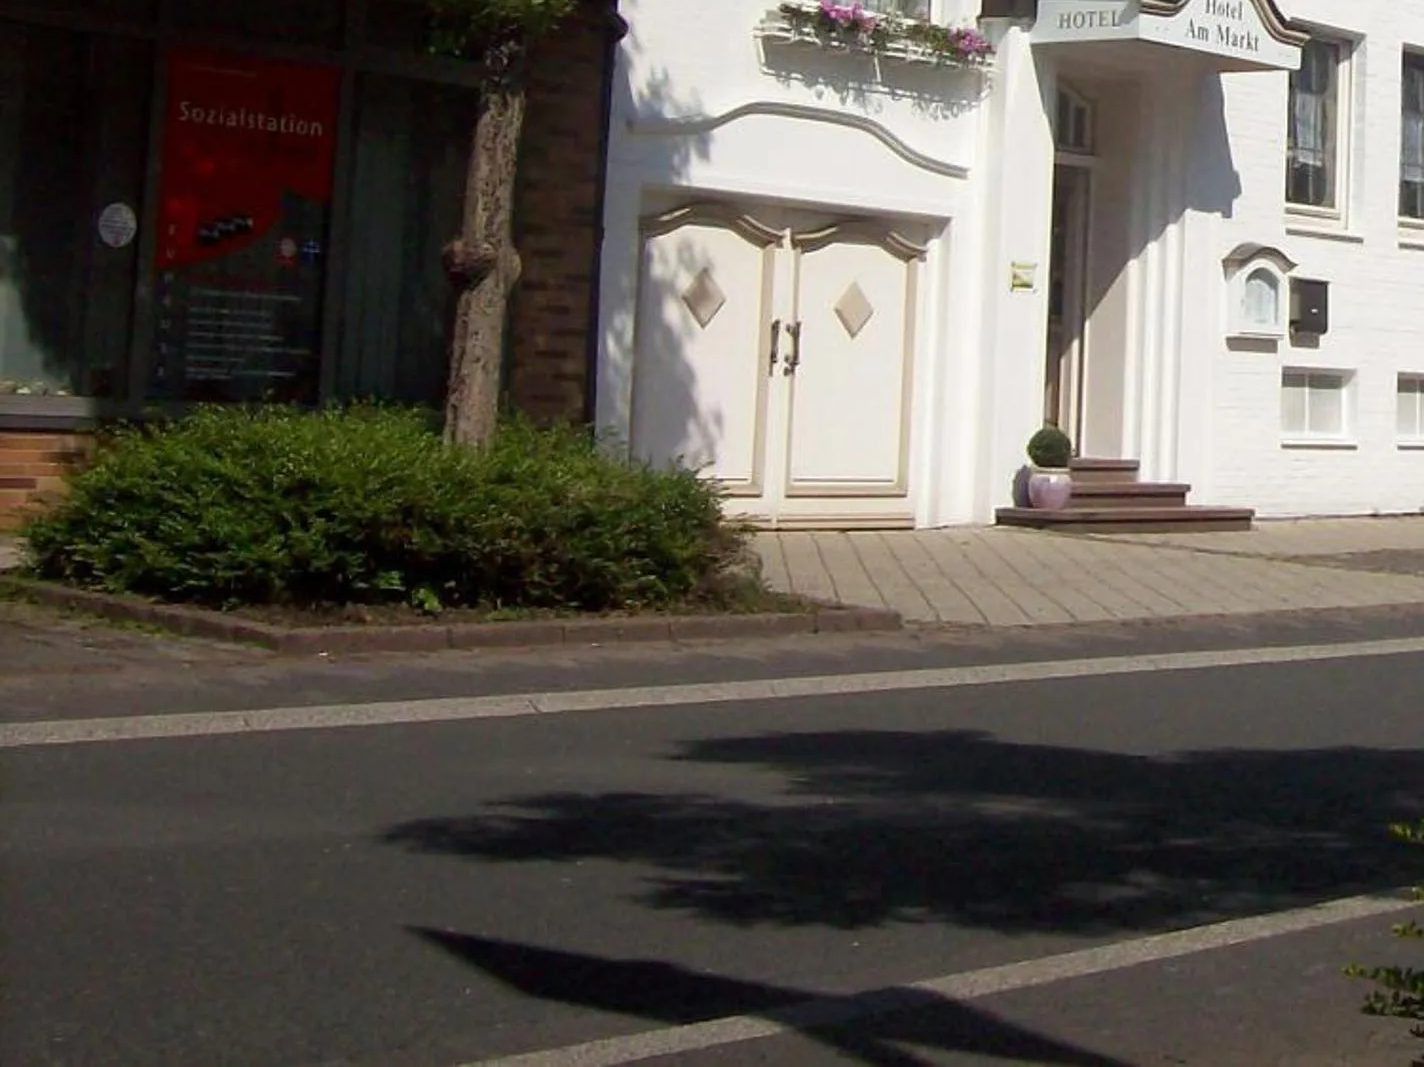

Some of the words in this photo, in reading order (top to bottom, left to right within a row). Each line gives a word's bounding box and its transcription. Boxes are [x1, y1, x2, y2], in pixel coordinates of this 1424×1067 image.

[1057, 9, 1120, 30] HOTEL
[1186, 19, 1210, 42] Am
[1217, 24, 1260, 52] Markt
[178, 100, 324, 138] Sozialstation
